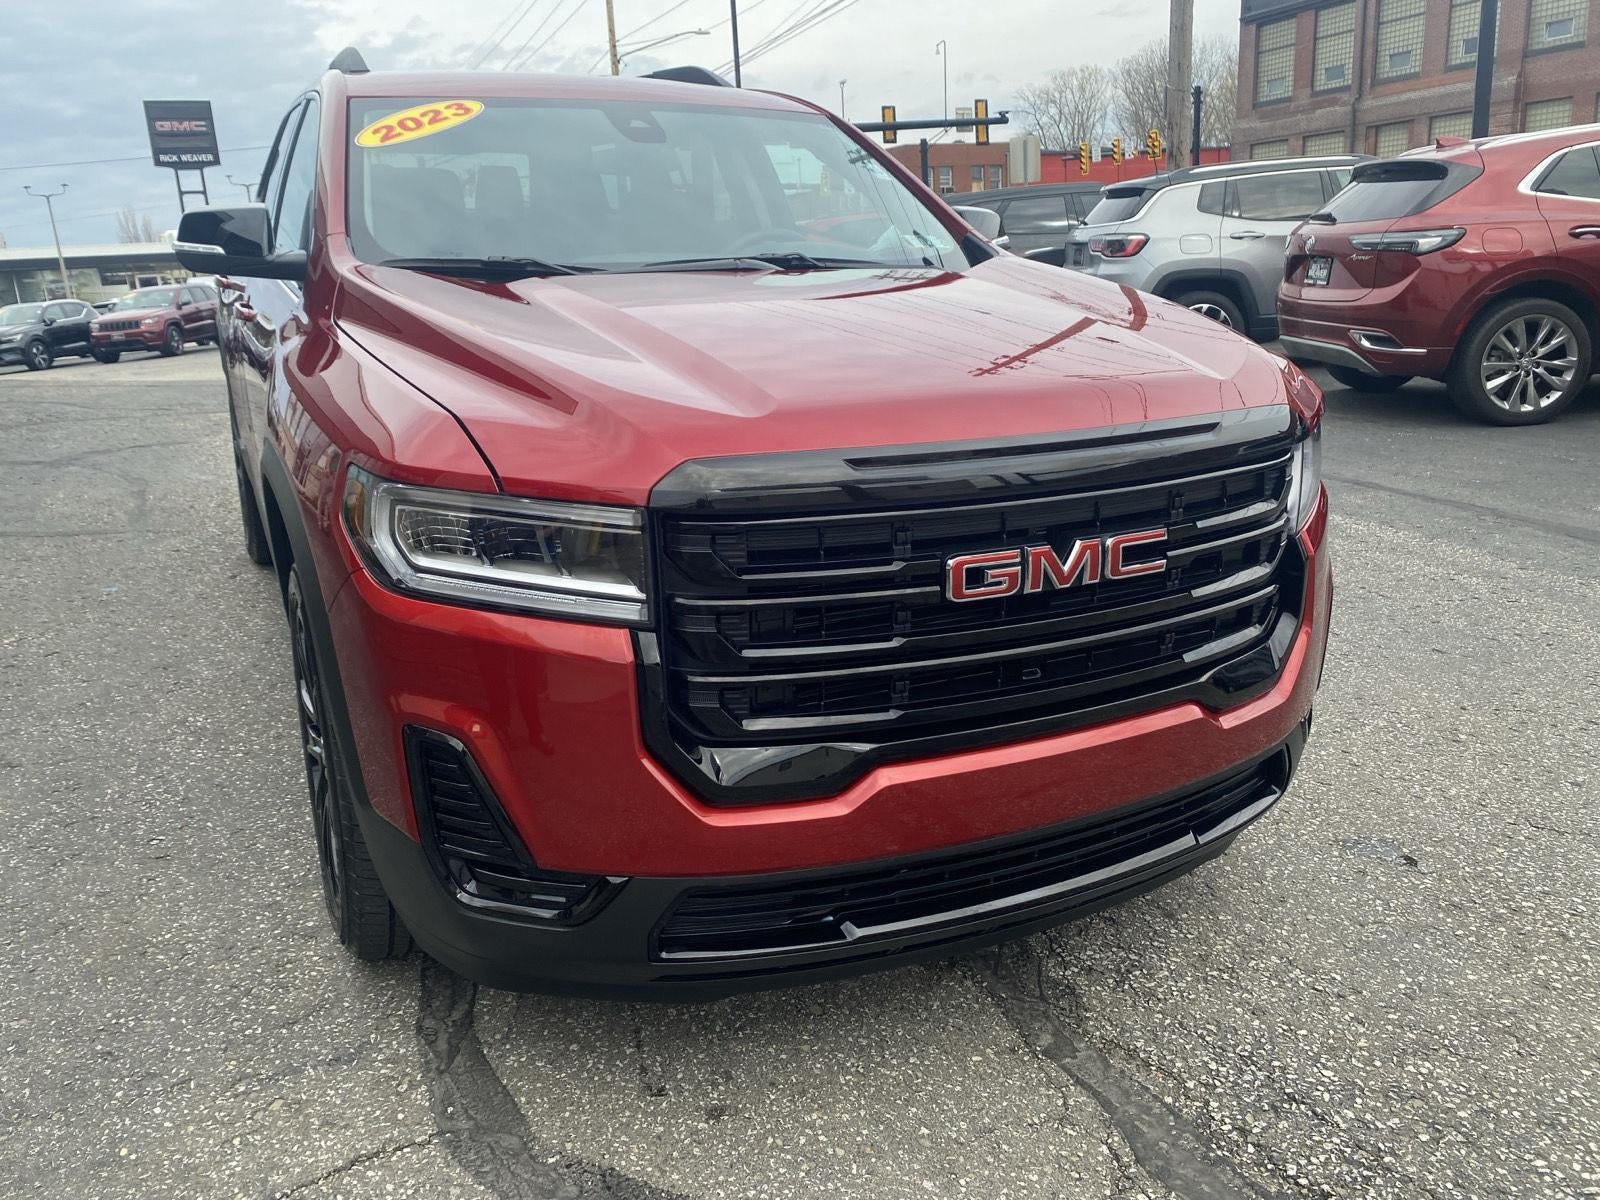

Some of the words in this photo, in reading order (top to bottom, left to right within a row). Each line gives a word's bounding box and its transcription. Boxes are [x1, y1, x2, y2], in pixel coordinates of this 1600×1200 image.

[154, 120, 208, 132] GMC
[371, 102, 473, 143] 2023
[159, 153, 179, 163] RICK
[180, 153, 214, 162] WEAVER
[946, 528, 1168, 602] GMC
